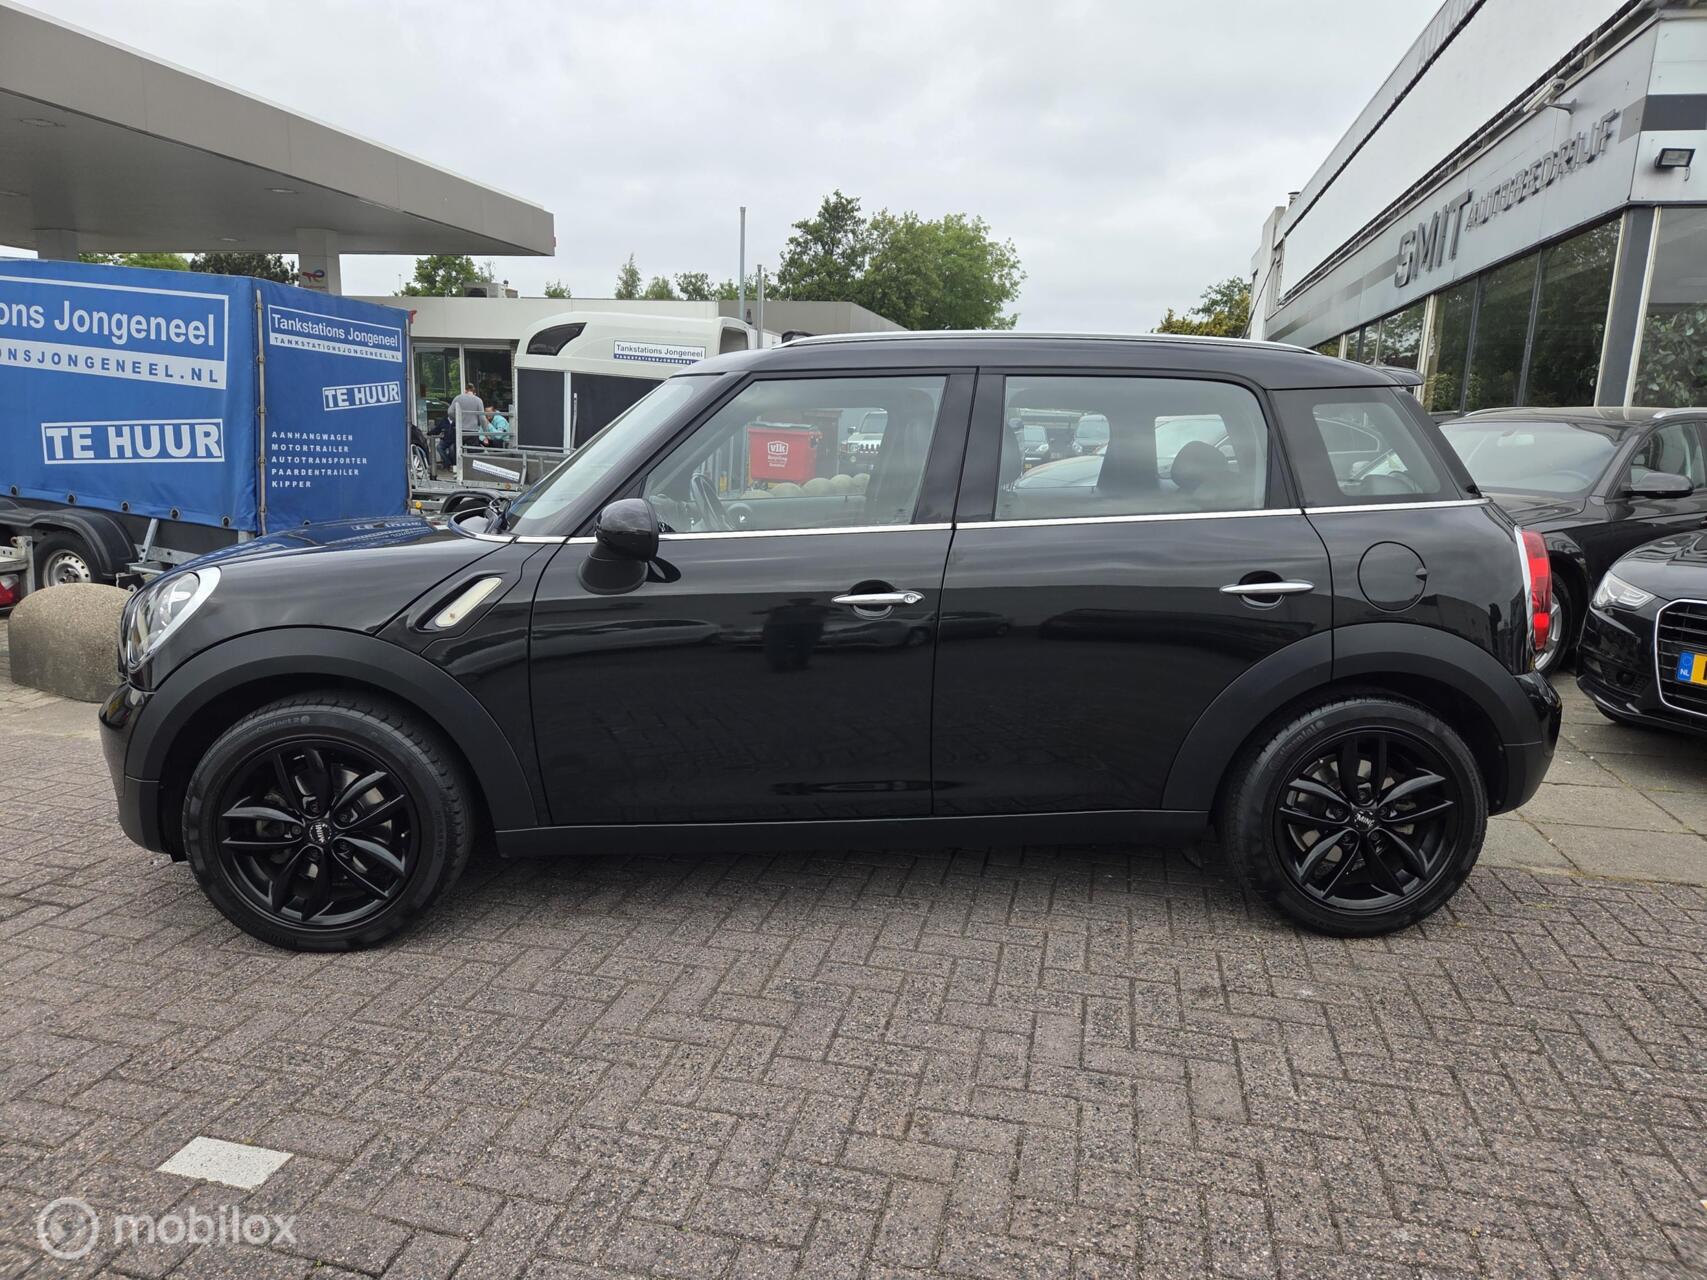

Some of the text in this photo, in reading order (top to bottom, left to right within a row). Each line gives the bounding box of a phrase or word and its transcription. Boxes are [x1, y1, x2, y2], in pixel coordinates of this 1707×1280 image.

[1394, 108, 1621, 288] SMIT AUTOBEDRIJF
[54, 300, 214, 346] Jongeneel
[272, 313, 398, 347] Tankstations Jongeneel
[275, 336, 400, 361] TANKSTATIONSJONGENEEL.NL
[616, 344, 703, 357] Tankstations Jongeneel
[0, 347, 218, 383] NSJONGENEEL.NL
[324, 384, 400, 408] TE HUUR
[45, 424, 222, 459] TE HUUR
[271, 431, 353, 441] AANHANGWAGEN
[271, 443, 349, 453] MOTORTRAILER
[271, 455, 368, 465] AUTOTRANSPORTER
[271, 468, 360, 476] PAARDENTRAILER
[271, 480, 312, 488] KIPPER
[1680, 668, 1690, 677] NL
